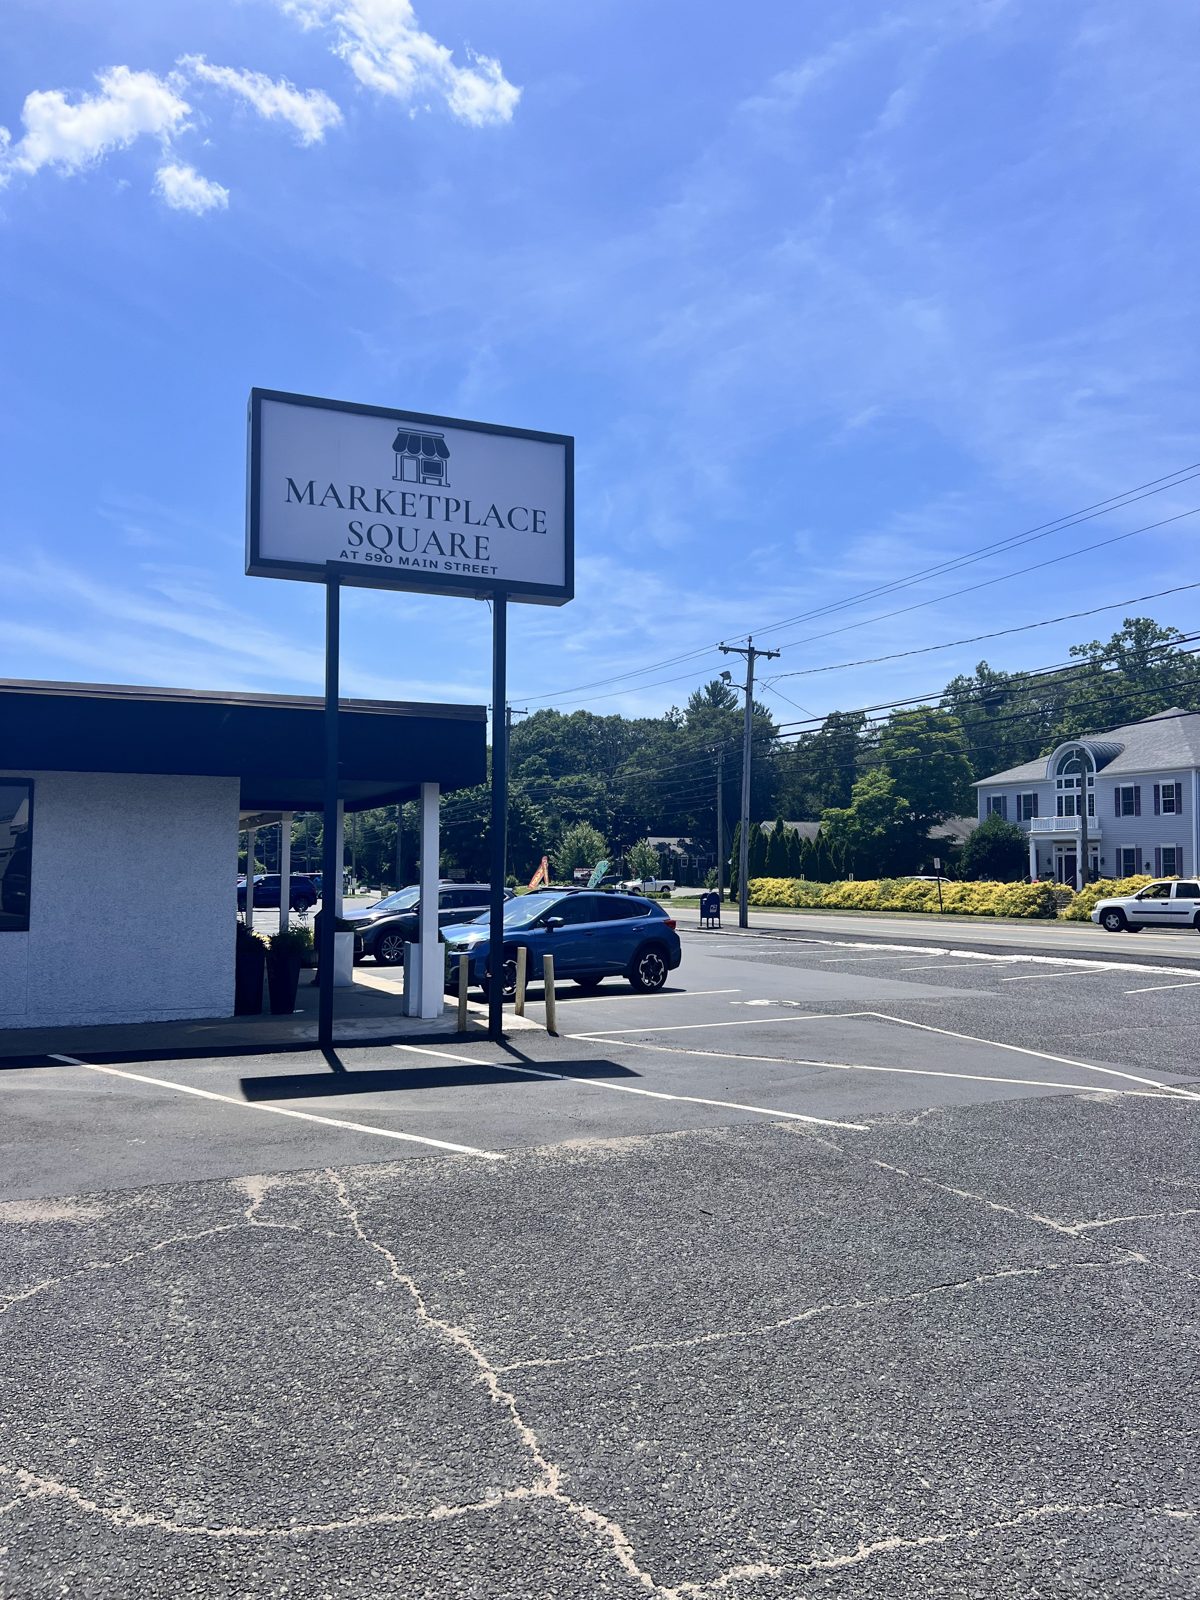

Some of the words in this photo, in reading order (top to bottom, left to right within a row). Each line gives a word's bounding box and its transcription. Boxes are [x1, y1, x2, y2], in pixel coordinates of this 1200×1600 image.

[284, 477, 548, 534] MARKETPLACE
[347, 520, 491, 561] SQUARE
[339, 549, 359, 560] AT
[364, 552, 393, 564] 590
[398, 556, 438, 569] MAIN
[444, 561, 498, 575] STREET
